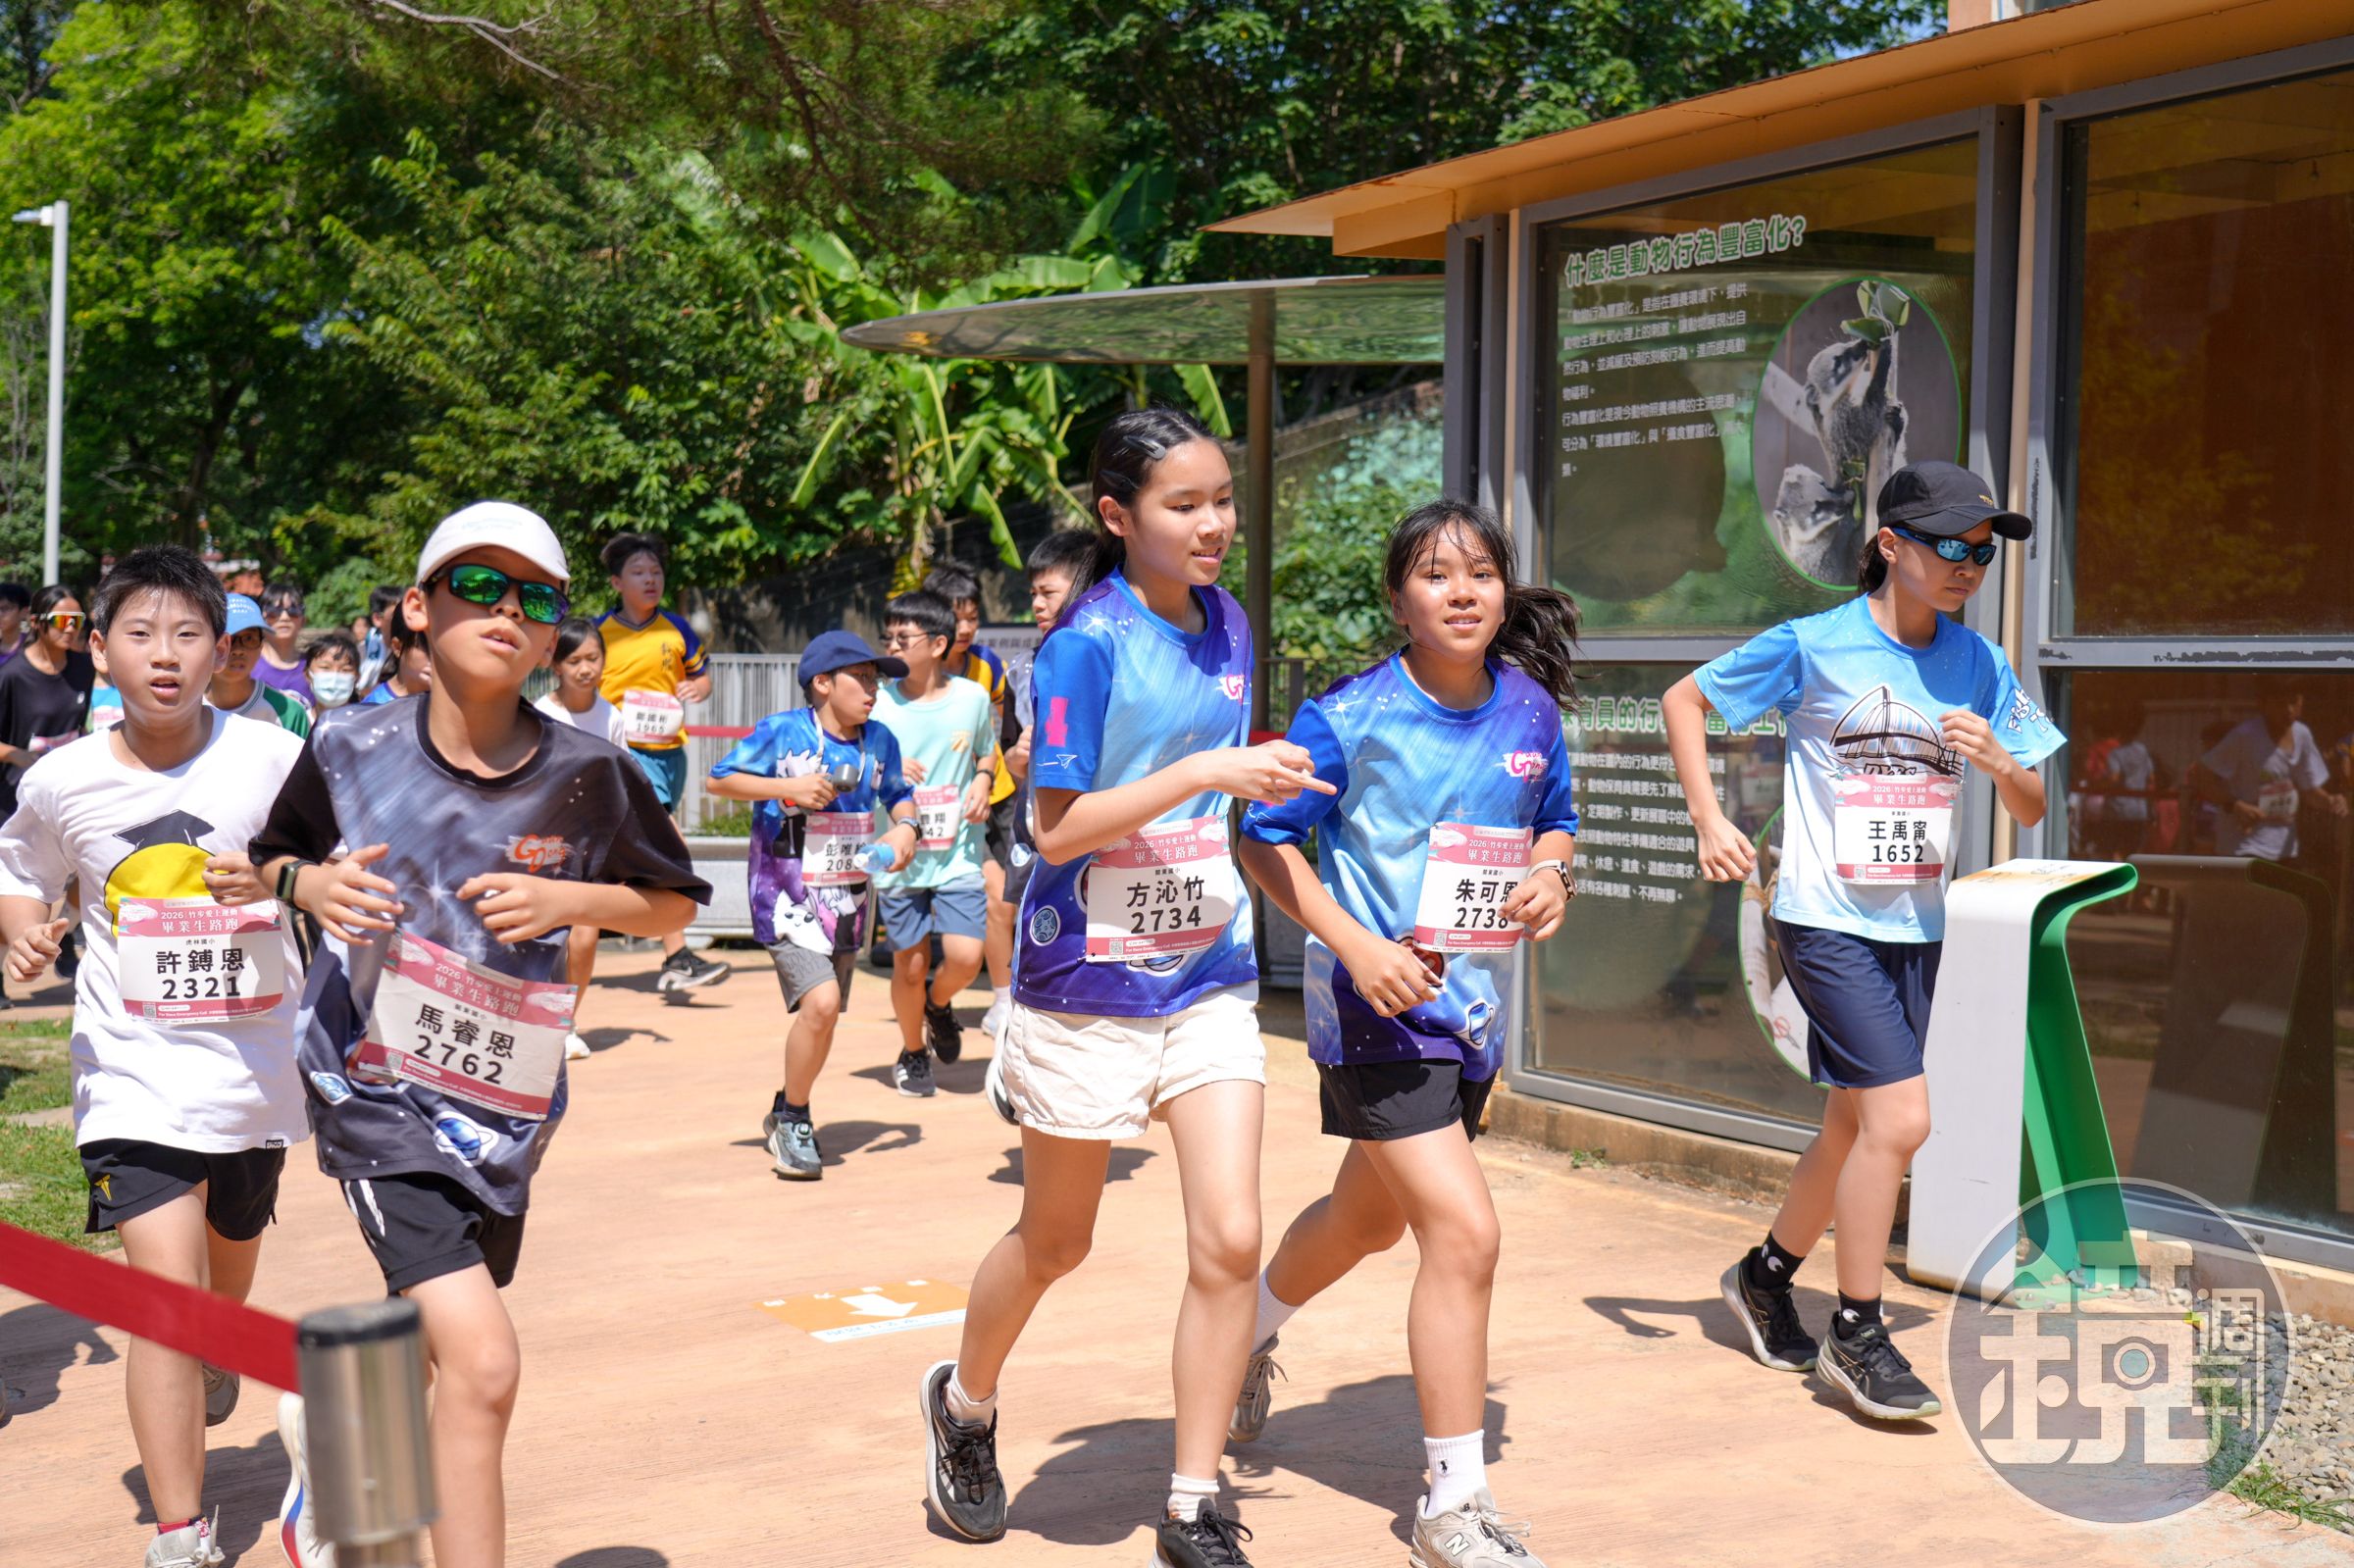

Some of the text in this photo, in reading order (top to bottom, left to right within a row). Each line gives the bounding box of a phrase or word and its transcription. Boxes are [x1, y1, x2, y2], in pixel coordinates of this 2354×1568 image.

[1134, 840, 1154, 849] 2026
[1135, 843, 1199, 864] 畢業生路跑
[1469, 839, 1487, 848] 2026
[1871, 844, 1924, 863] 1652
[1468, 848, 1523, 863] 畢業生路跑
[1126, 876, 1205, 908] 方沁竹
[162, 918, 238, 934] 畢業生路跑
[1130, 905, 1202, 934] 2734
[156, 947, 245, 974] 許鎛恩
[435, 963, 462, 980] 2026
[162, 976, 241, 999] 2321
[435, 974, 520, 1017] 畢業生路跑
[416, 1003, 515, 1060] 馬睿恩
[414, 1035, 503, 1086] 2762
